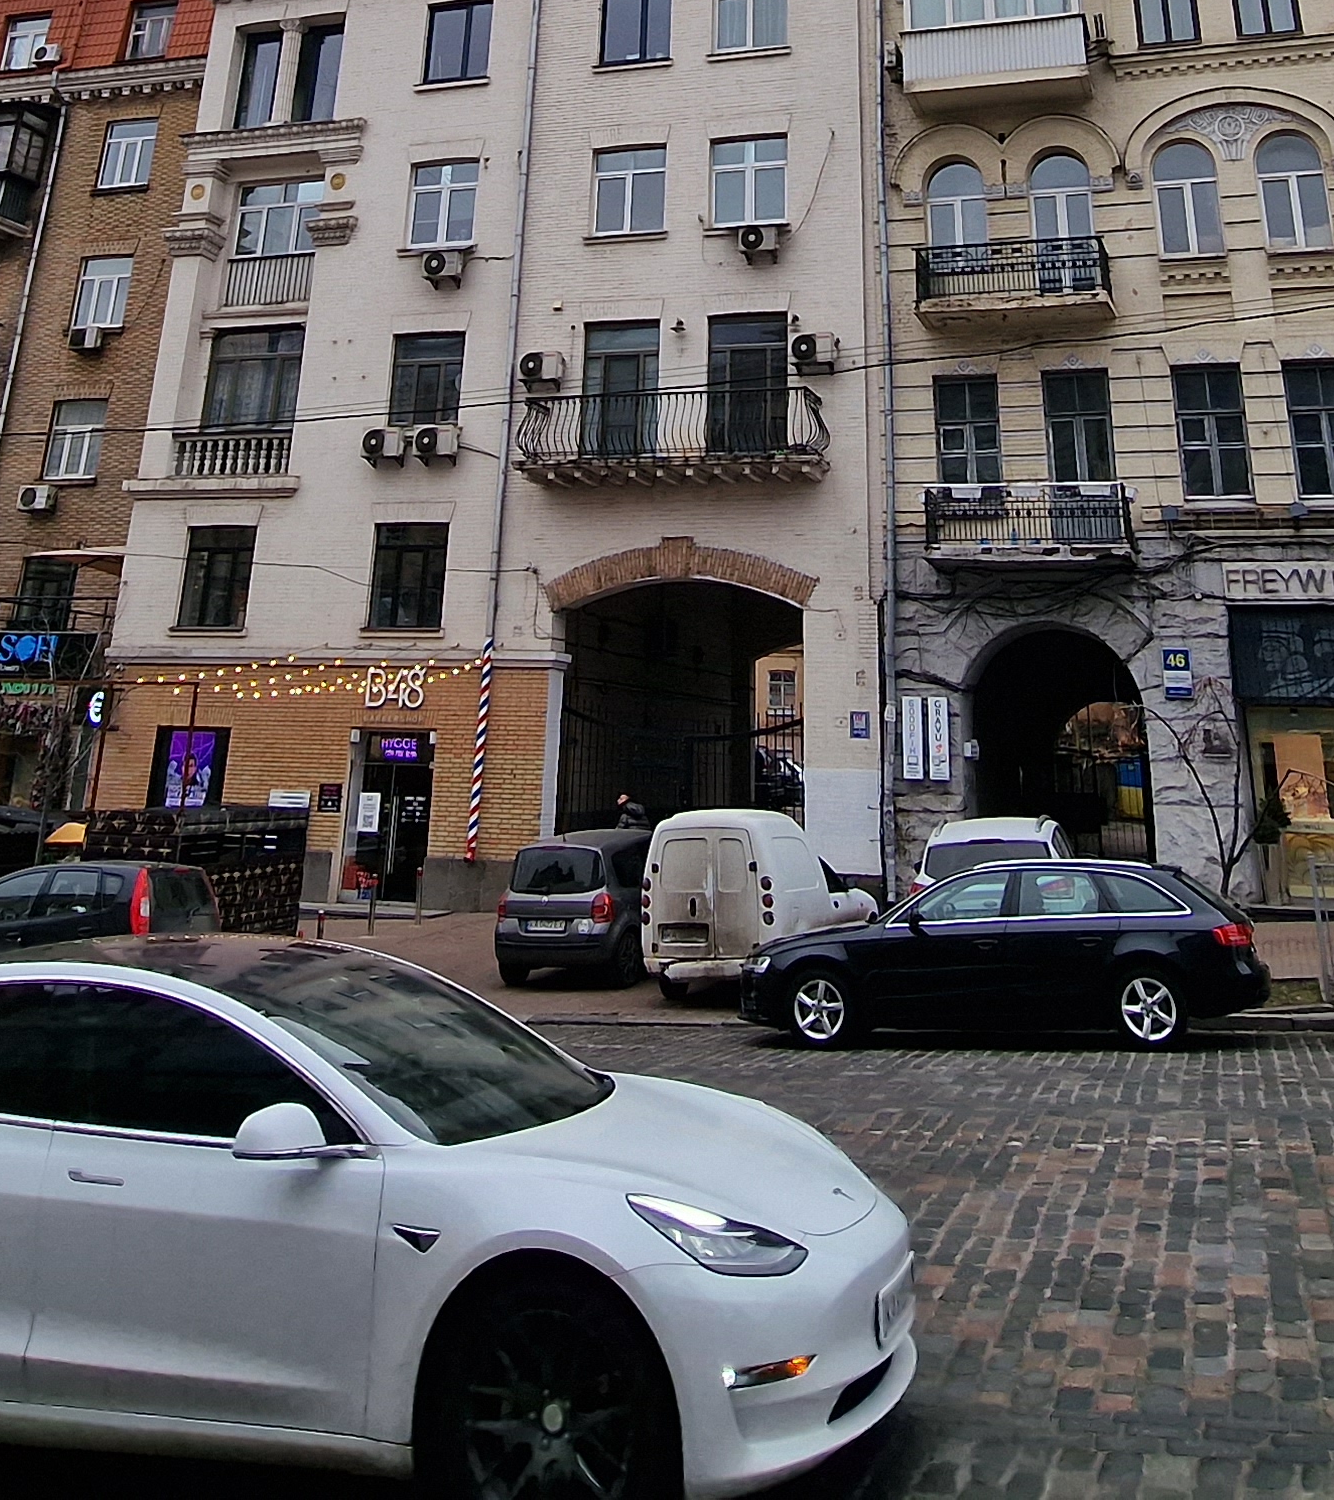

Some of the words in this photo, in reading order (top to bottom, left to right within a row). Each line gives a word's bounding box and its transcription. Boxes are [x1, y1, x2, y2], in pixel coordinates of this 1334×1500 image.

[1166, 653, 1186, 668] 46
[365, 667, 427, 708] B48
[381, 737, 418, 750] HYGGE
